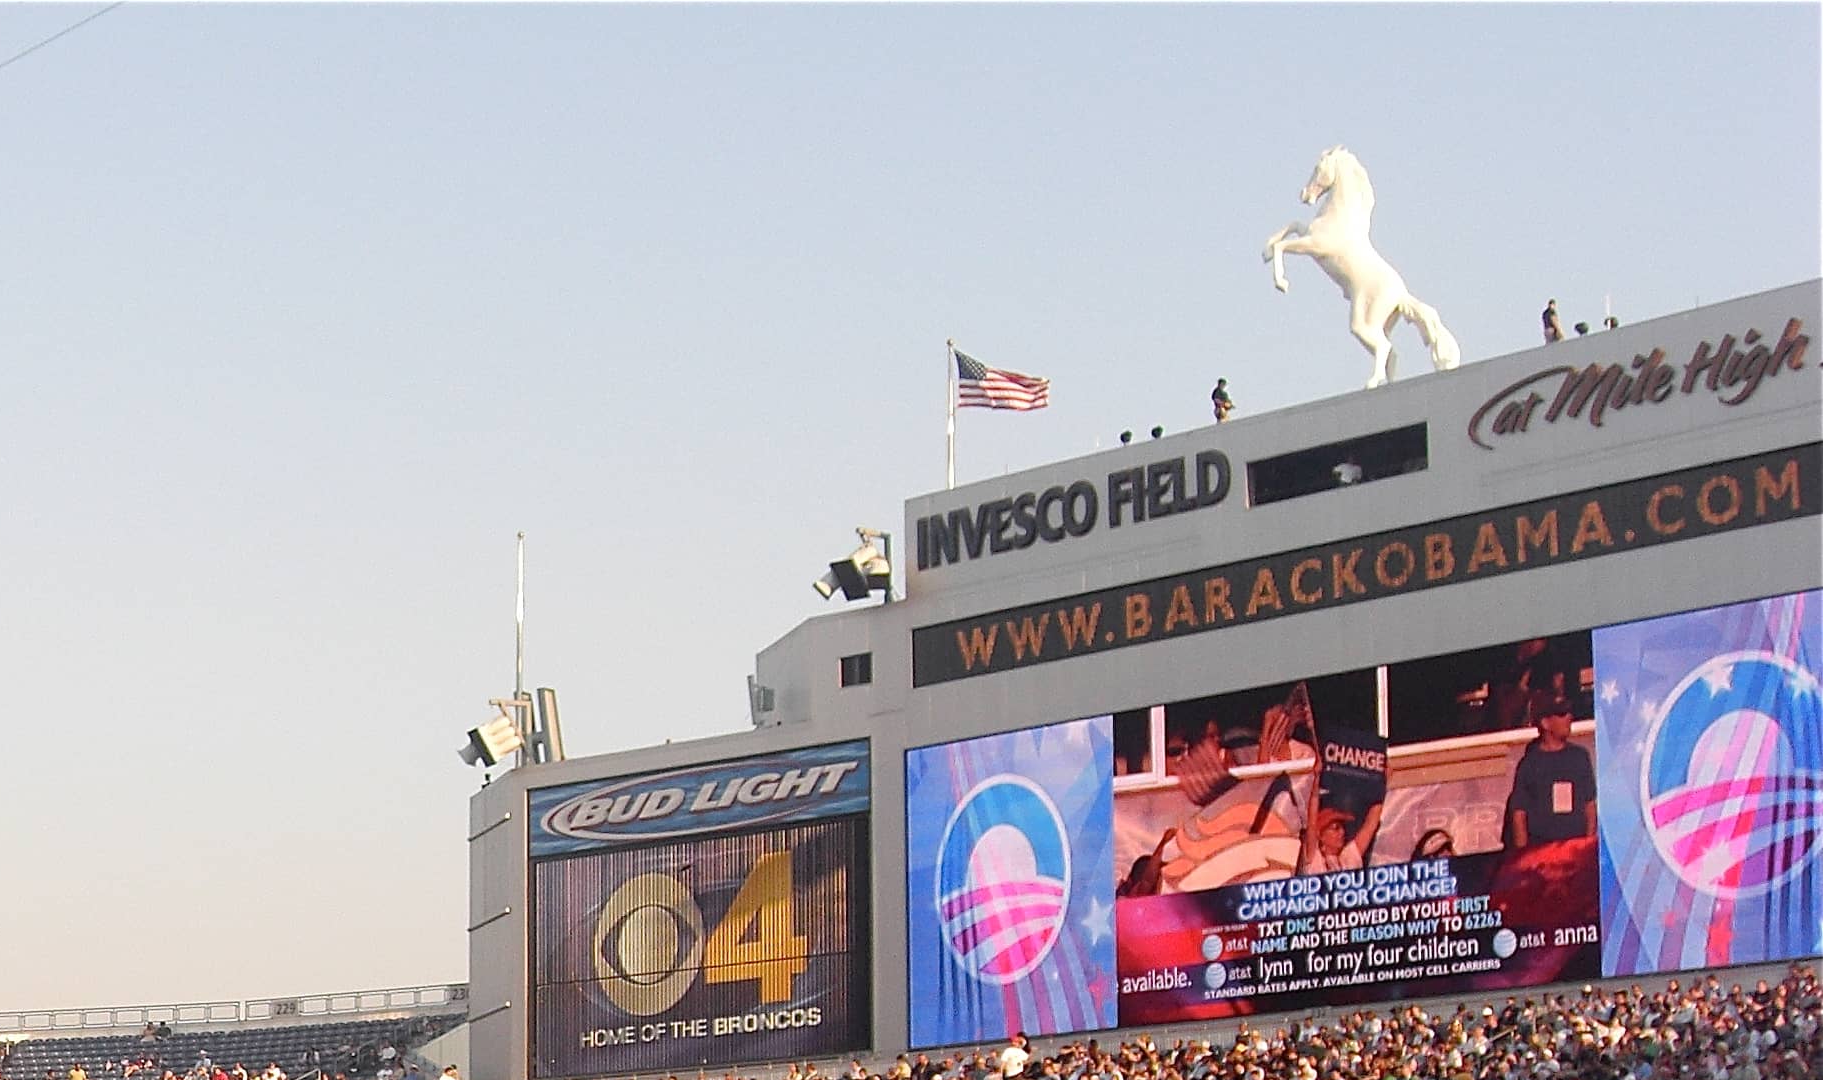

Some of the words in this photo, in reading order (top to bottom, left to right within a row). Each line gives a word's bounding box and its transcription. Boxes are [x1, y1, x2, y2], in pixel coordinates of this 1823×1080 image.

[1545, 347, 1675, 427] Mile
[1681, 318, 1810, 406] High
[917, 479, 1098, 571] INVESCO
[1108, 449, 1232, 528] FIELD
[956, 459, 1802, 672] WWW.BARACKOBAMA.COM
[1325, 743, 1385, 771] CHANGE
[570, 788, 686, 830] BUD
[690, 761, 859, 811] LIGHT
[1238, 894, 1328, 920] CAMPAIGN
[1333, 889, 1369, 909] FOR
[1373, 876, 1458, 903] CHANGE?
[1244, 881, 1286, 901] WHY
[1289, 878, 1321, 897] DID
[1326, 871, 1365, 891] YOU
[1368, 866, 1409, 889] JOIN
[1412, 859, 1450, 879] THE
[705, 850, 808, 1005] 4
[1251, 937, 1287, 954] NAME
[1291, 933, 1320, 950] AND
[1323, 930, 1348, 946] THE
[1351, 922, 1404, 943] REASON
[1407, 917, 1438, 936] WHY
[1444, 916, 1462, 933] TO
[1465, 911, 1502, 930] 62262
[1258, 920, 1284, 937] TXT
[1286, 918, 1315, 934] DNC
[1318, 910, 1388, 930] FOLLOWED
[1391, 906, 1410, 922] BY
[1412, 901, 1450, 919] YOUR
[1452, 896, 1490, 913] FIRST
[1123, 967, 1193, 994] available.
[1258, 957, 1292, 984] lynn
[1308, 951, 1332, 973] for
[1337, 951, 1361, 974] my
[1366, 943, 1402, 967] four
[1408, 934, 1479, 962] children
[1554, 924, 1599, 946] anna
[451, 987, 469, 1001] 23
[582, 1025, 635, 1049] HOME
[641, 1022, 667, 1042] OF
[670, 1018, 707, 1039] THE
[713, 1006, 822, 1037] BRONCOS
